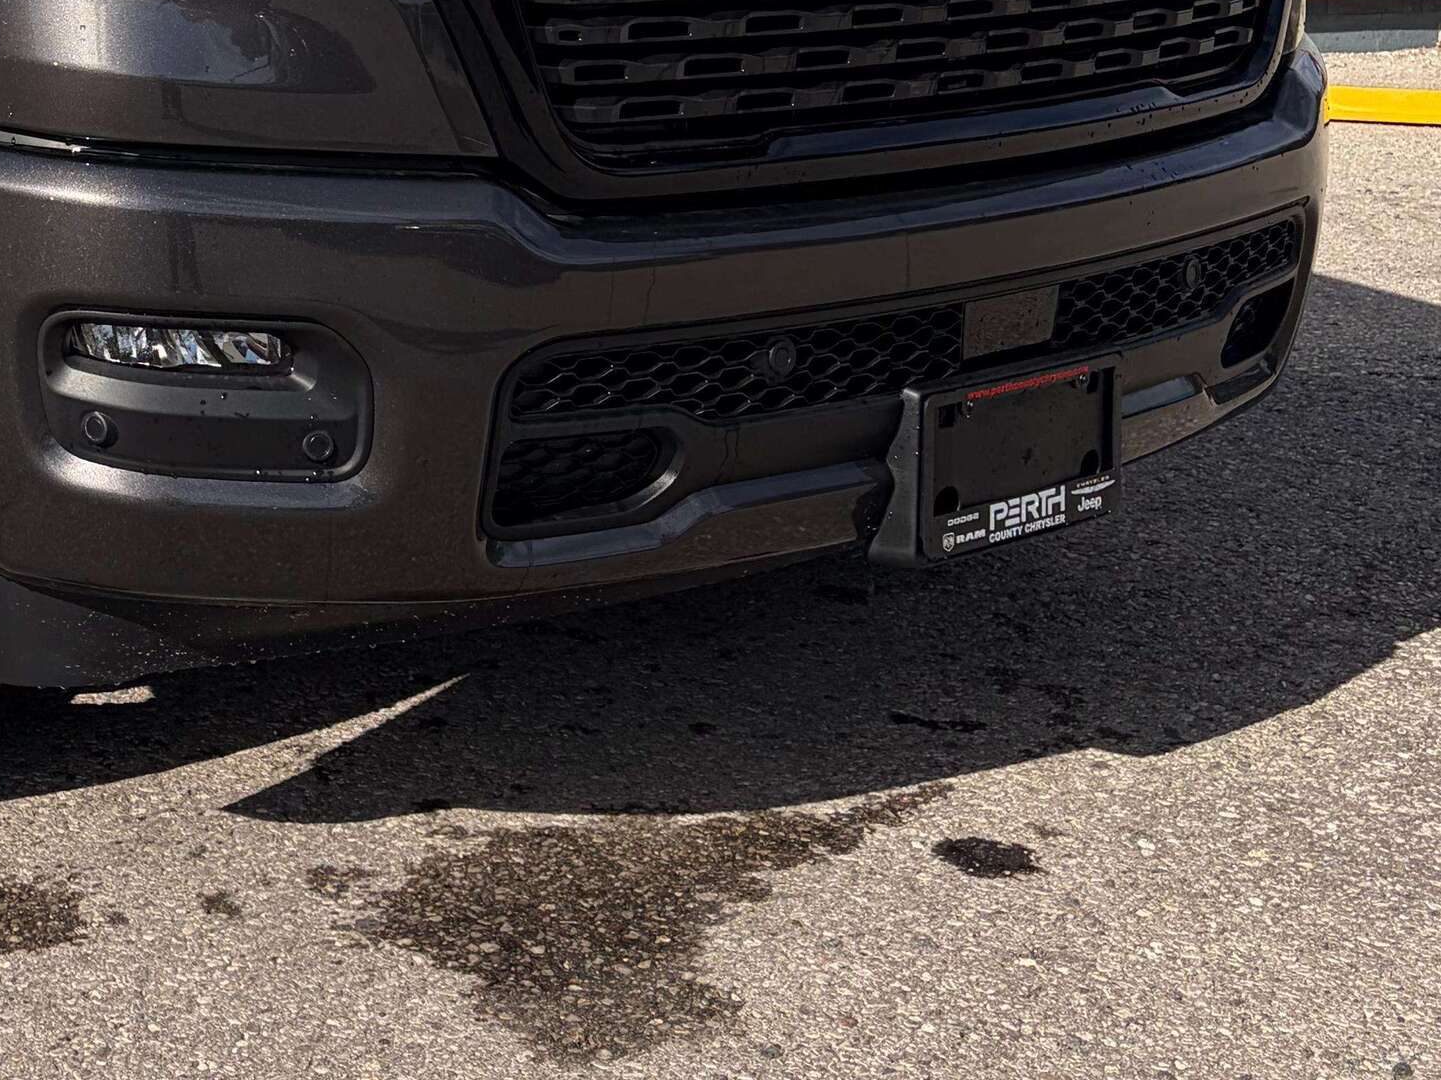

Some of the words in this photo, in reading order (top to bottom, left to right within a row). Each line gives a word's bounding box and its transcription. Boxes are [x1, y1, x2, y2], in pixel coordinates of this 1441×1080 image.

[989, 485, 1066, 531] PERTH
[1077, 496, 1102, 512] Jeep
[956, 529, 986, 544] RAM
[989, 525, 1023, 543] COUNTY
[1024, 514, 1066, 534] CHRYSLER
